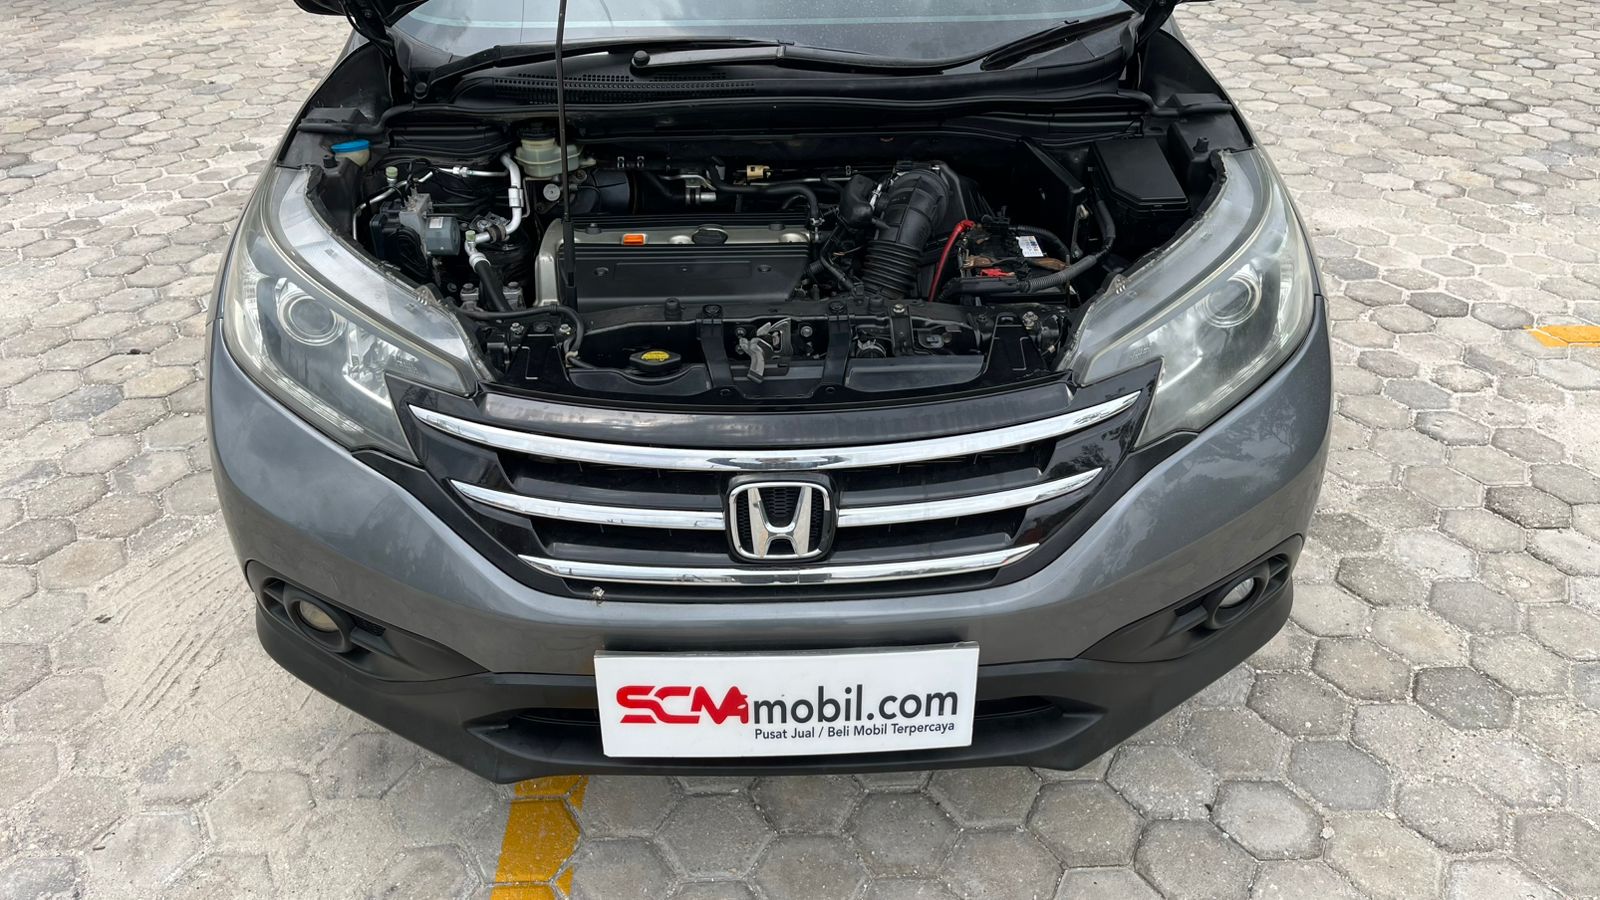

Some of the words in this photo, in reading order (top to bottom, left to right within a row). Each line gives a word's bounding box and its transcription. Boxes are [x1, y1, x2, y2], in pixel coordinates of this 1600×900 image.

[754, 728, 788, 740] Pusat
[791, 726, 815, 739] Jual
[827, 725, 850, 738] Beli
[853, 723, 887, 737] Mobil
[891, 722, 955, 736] Terpercaya
